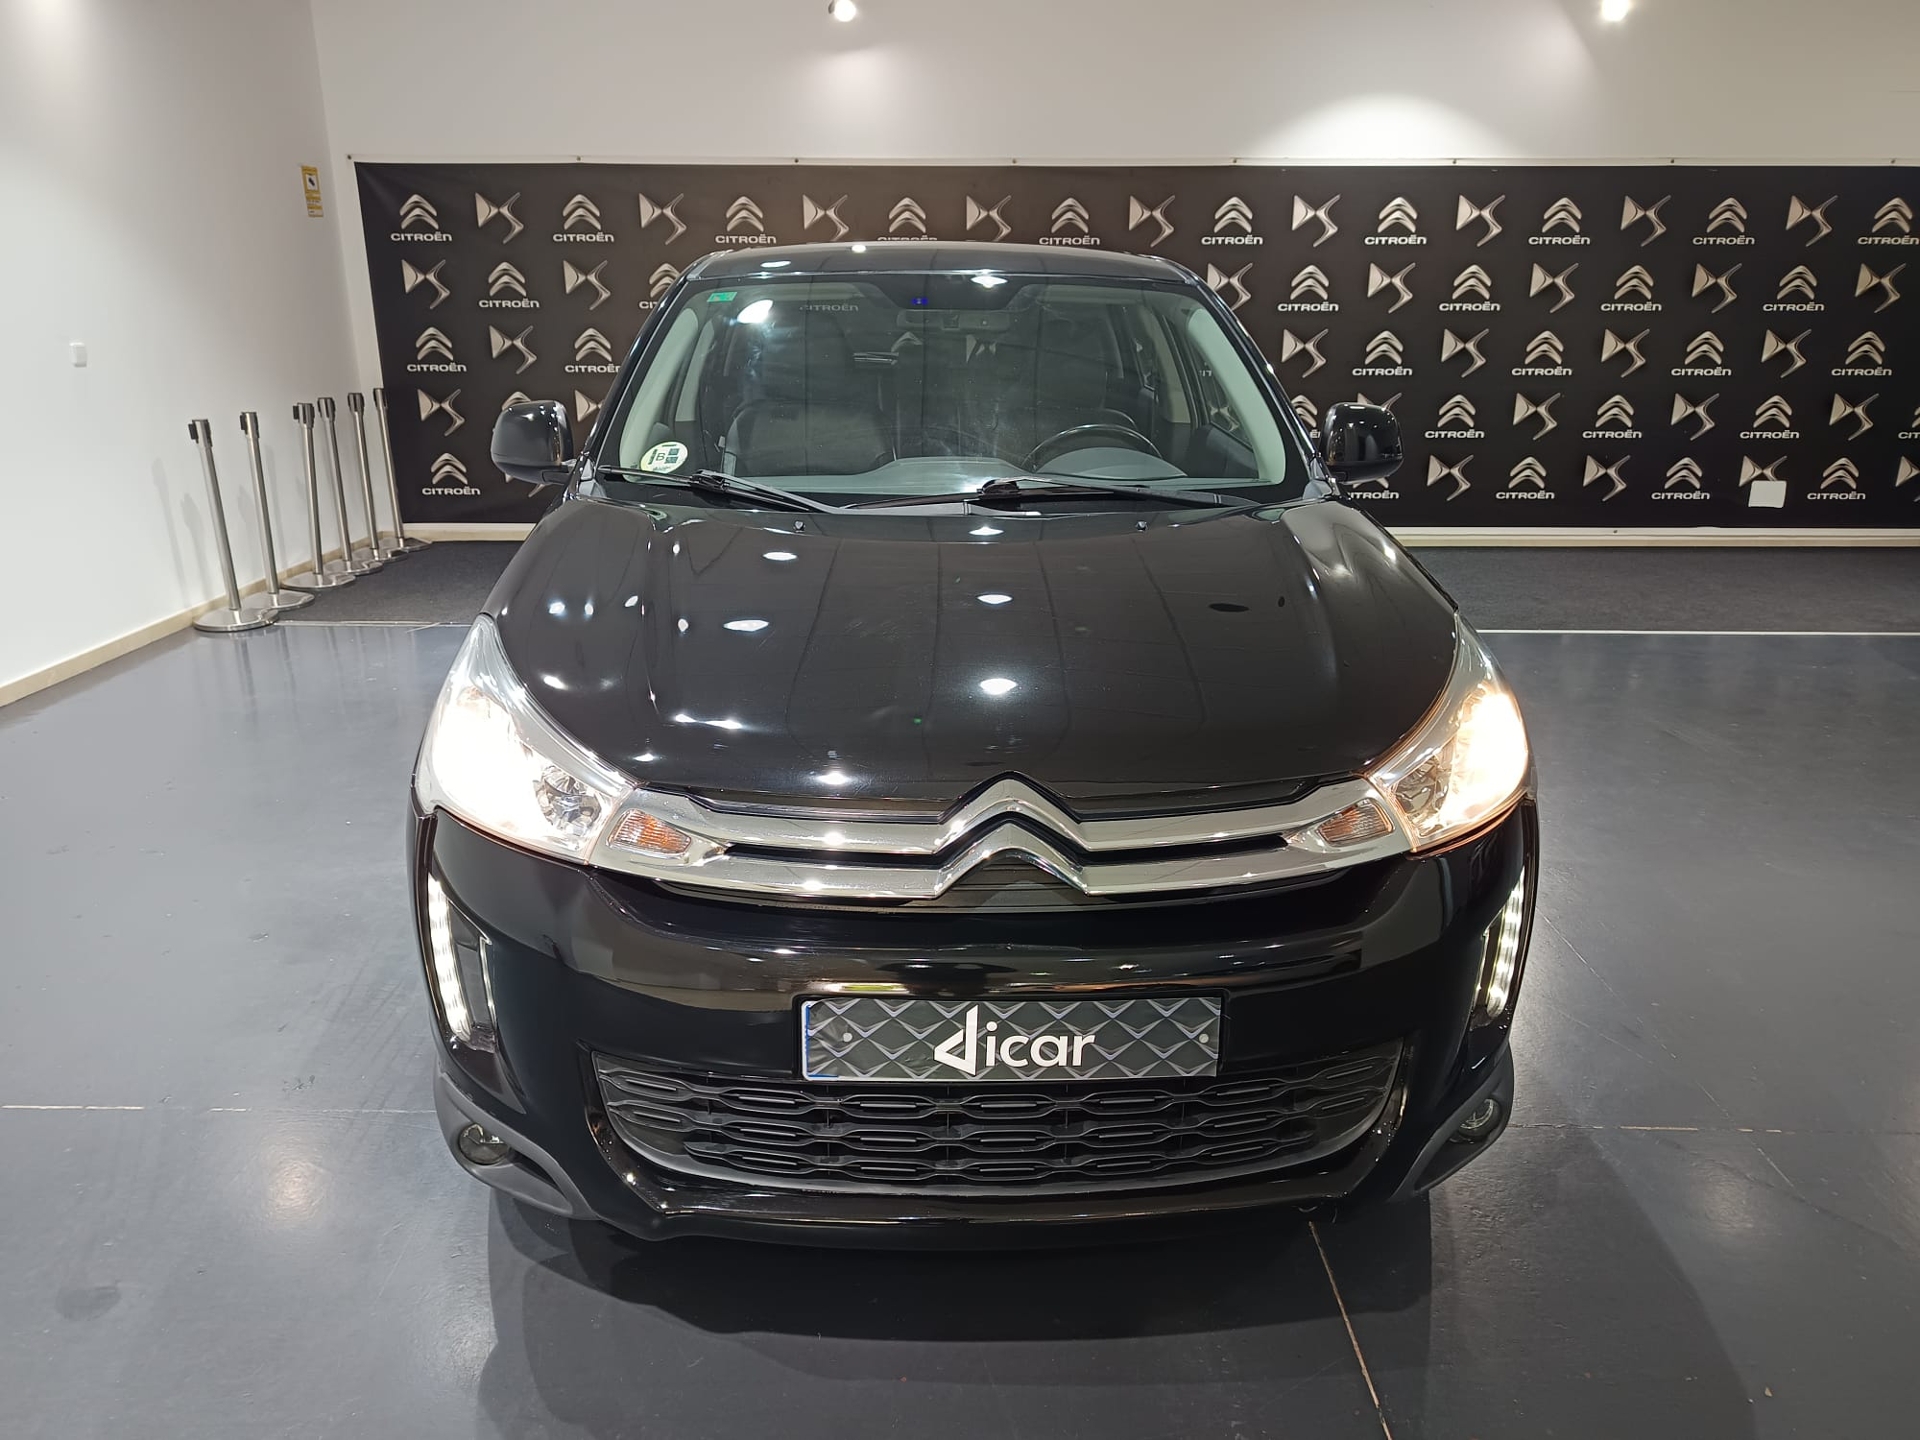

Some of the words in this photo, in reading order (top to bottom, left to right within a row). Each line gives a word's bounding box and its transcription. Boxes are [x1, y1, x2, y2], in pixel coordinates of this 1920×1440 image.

[391, 230, 452, 241] CITROËN
[553, 231, 614, 242] CITROËN
[715, 233, 777, 244] CITROËN
[1039, 235, 1100, 246] CITROËN
[1201, 234, 1263, 245] CITROËN
[1365, 234, 1427, 245] CITROËN
[1528, 234, 1590, 245] CITROËN
[1693, 234, 1755, 245] CITROËN
[1858, 234, 1919, 245] CITROËN
[479, 297, 540, 308] CITROËN
[1278, 300, 1339, 311] CITROËN
[1439, 300, 1501, 311] CITROËN
[1601, 300, 1662, 311] CITROËN
[1763, 300, 1824, 311] CITROËN
[407, 361, 467, 372] CITROËN
[1352, 365, 1412, 376] CITROËN
[1512, 364, 1572, 375] CITROËN
[1671, 365, 1731, 376] CITROËN
[1831, 365, 1892, 376] CITROËN
[1425, 427, 1485, 438] CITROËN
[1582, 427, 1642, 438] CITROËN
[1740, 428, 1799, 439] CITROËN
[655, 452, 666, 462] B
[422, 484, 481, 495] CITROËN
[1347, 490, 1399, 499] ITROËN
[1496, 488, 1555, 499] CITROËN
[1651, 488, 1710, 499] CITROËN
[1807, 489, 1866, 500] CITROËN
[933, 1004, 1096, 1076] dicar
